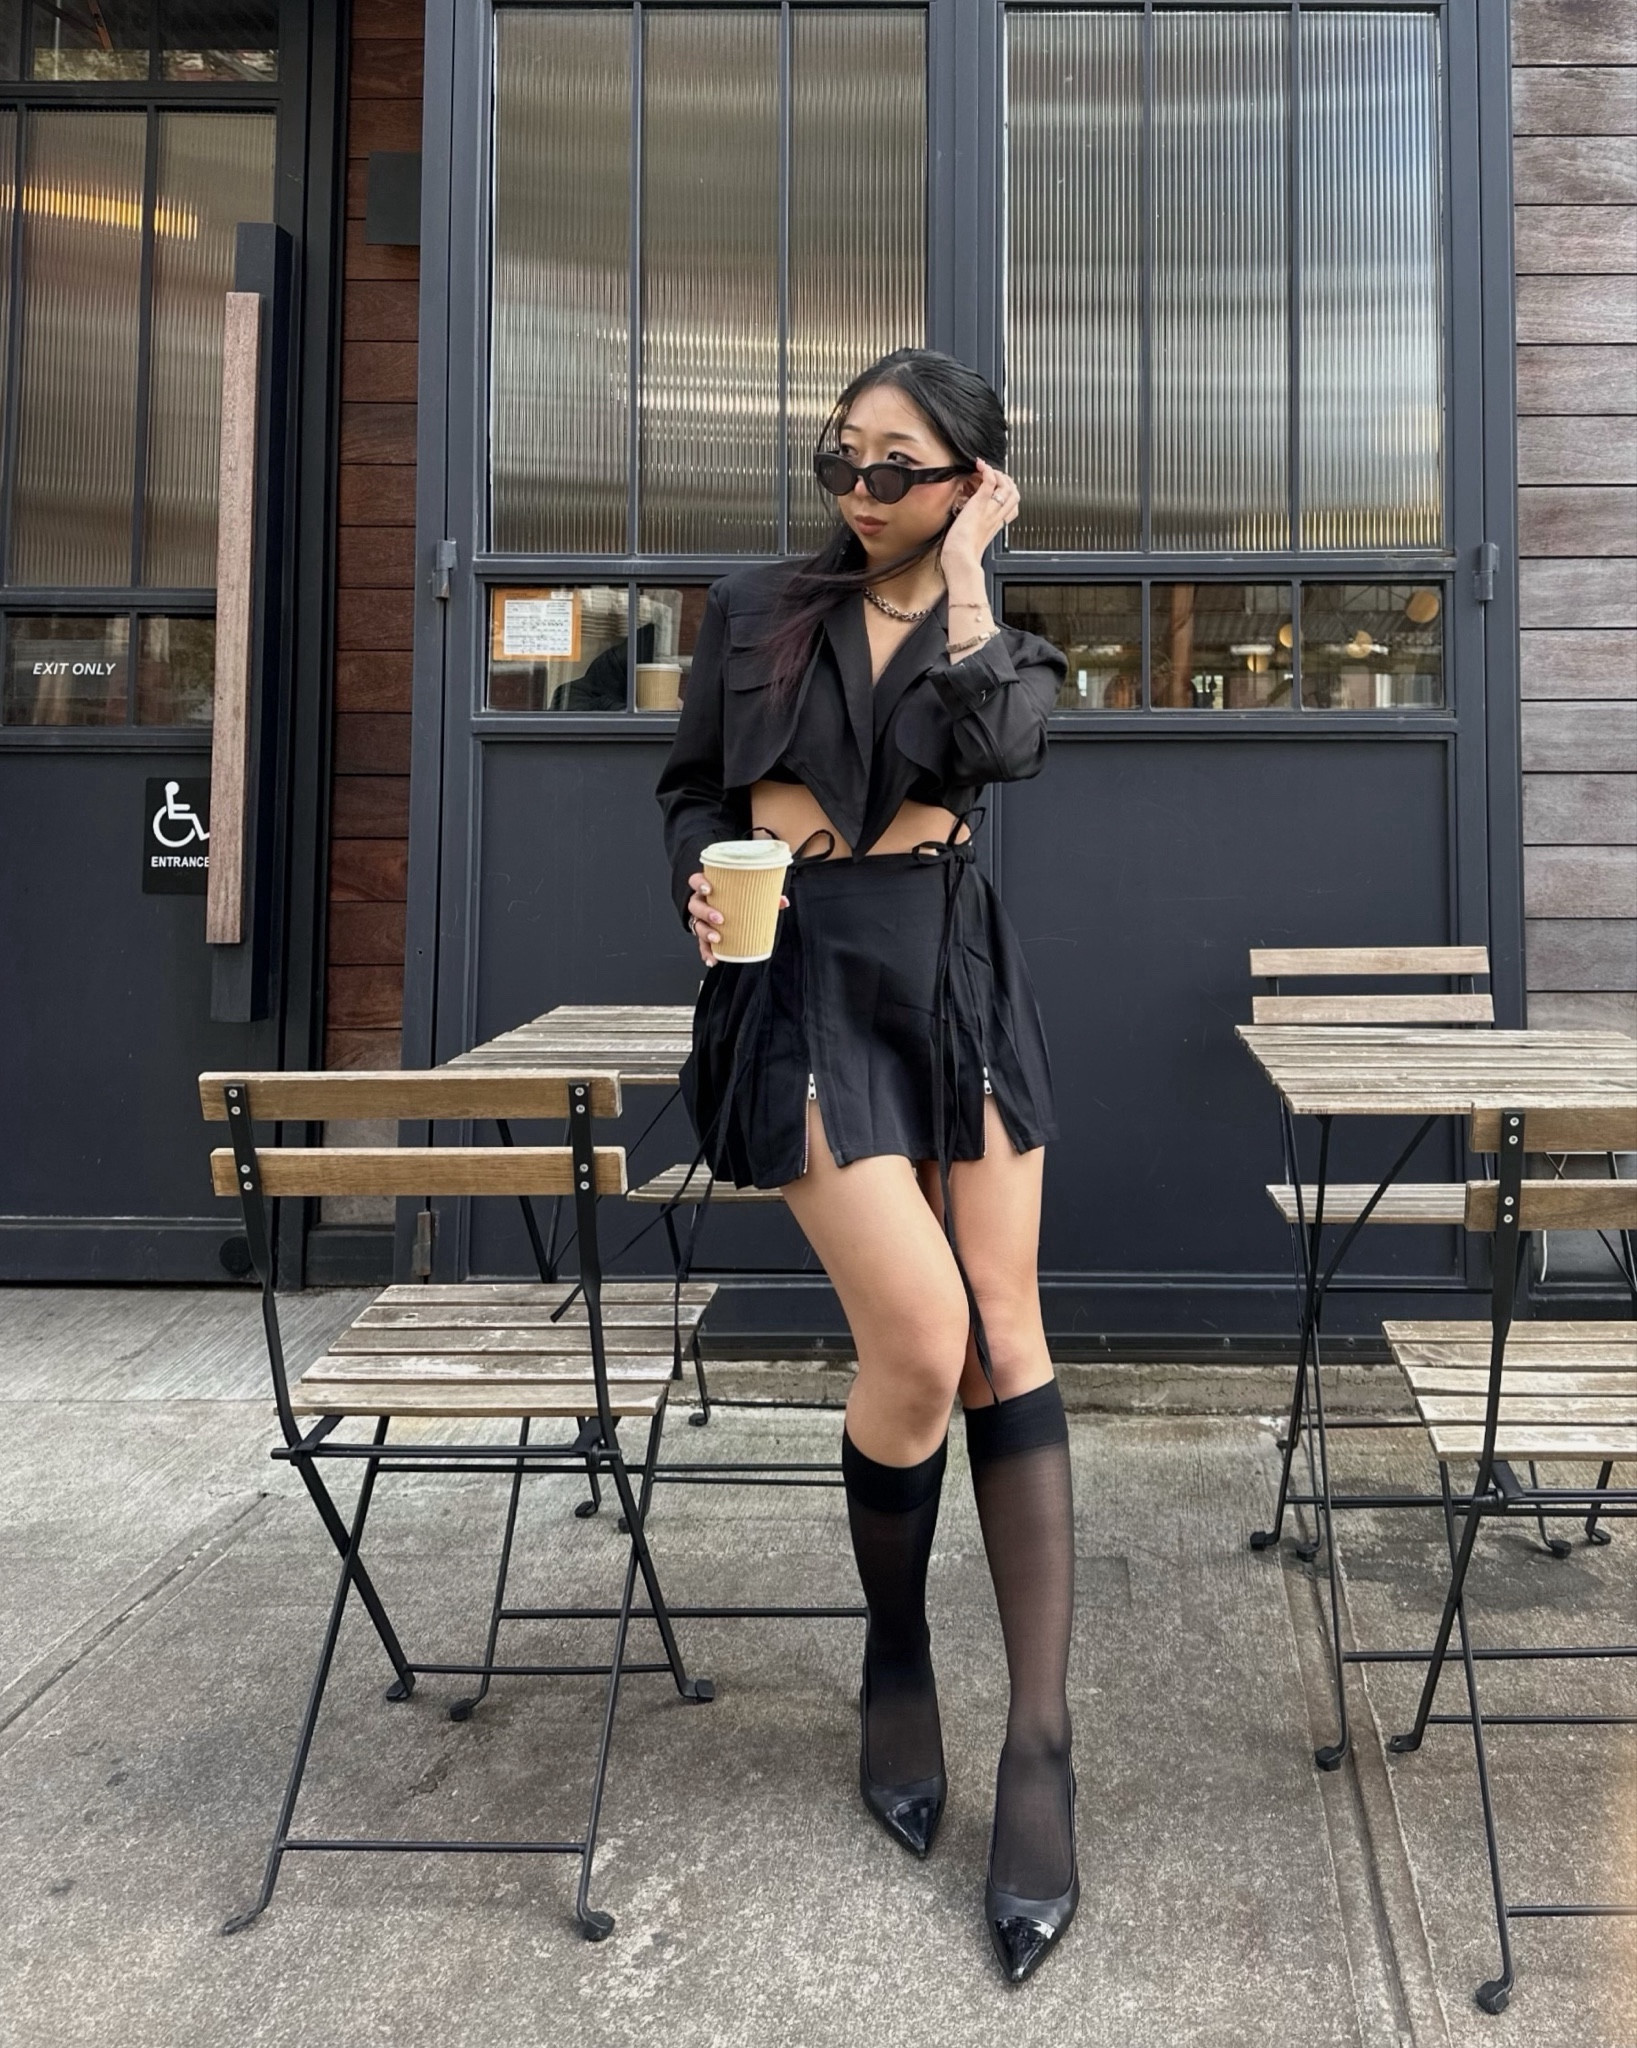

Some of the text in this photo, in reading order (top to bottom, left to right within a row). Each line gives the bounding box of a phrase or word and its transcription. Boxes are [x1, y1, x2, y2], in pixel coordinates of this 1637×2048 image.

[32, 662, 116, 675] EXIT ONLY
[151, 856, 210, 867] ENTRANCE
